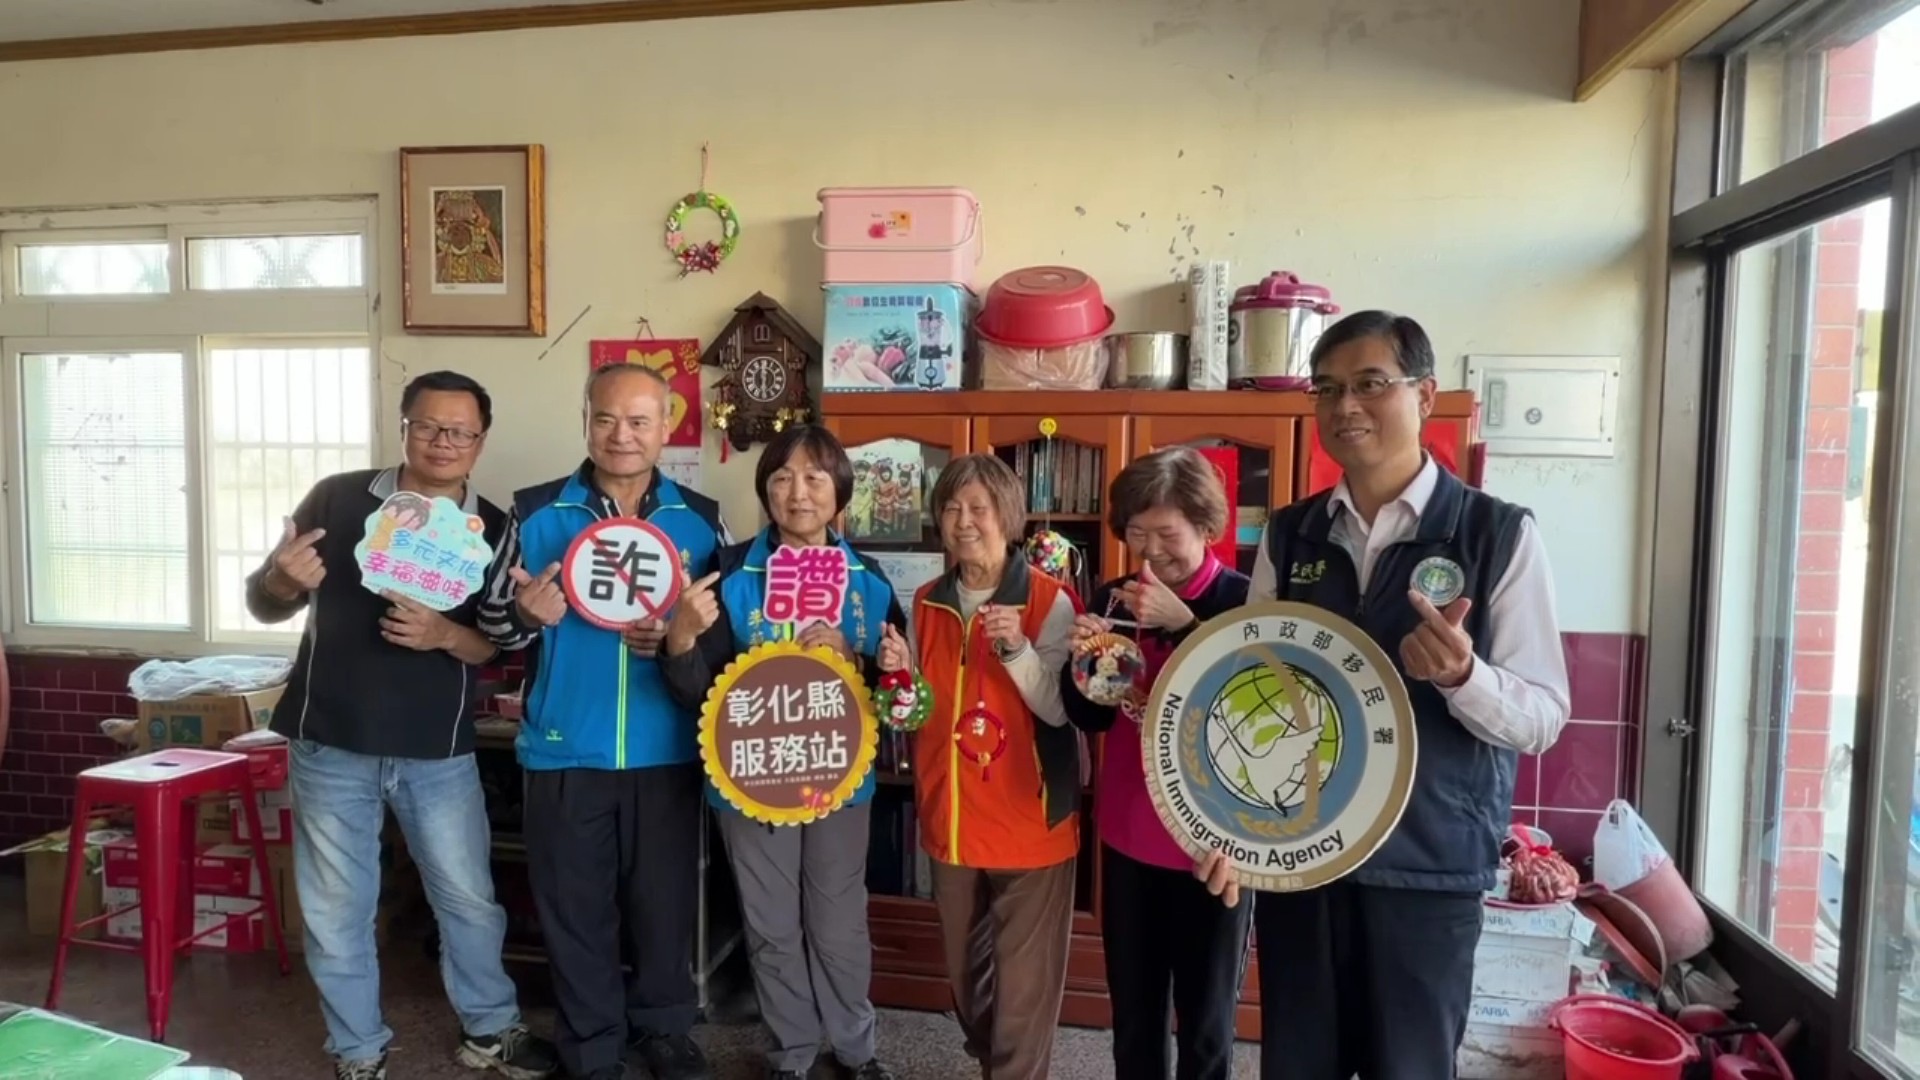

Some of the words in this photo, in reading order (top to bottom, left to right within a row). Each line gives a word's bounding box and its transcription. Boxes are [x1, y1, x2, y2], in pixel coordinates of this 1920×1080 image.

[363, 550, 468, 600] 幸福滋味
[391, 529, 482, 582] 多元文化
[589, 538, 660, 607] 詐
[766, 547, 847, 625] 讚
[726, 678, 847, 729] 彰化縣
[1242, 620, 1395, 745] 內政部移民署
[729, 730, 848, 779] 服務站
[1159, 693, 1183, 776] National
[1166, 778, 1260, 867] Immigration
[1265, 829, 1346, 871] Agency
